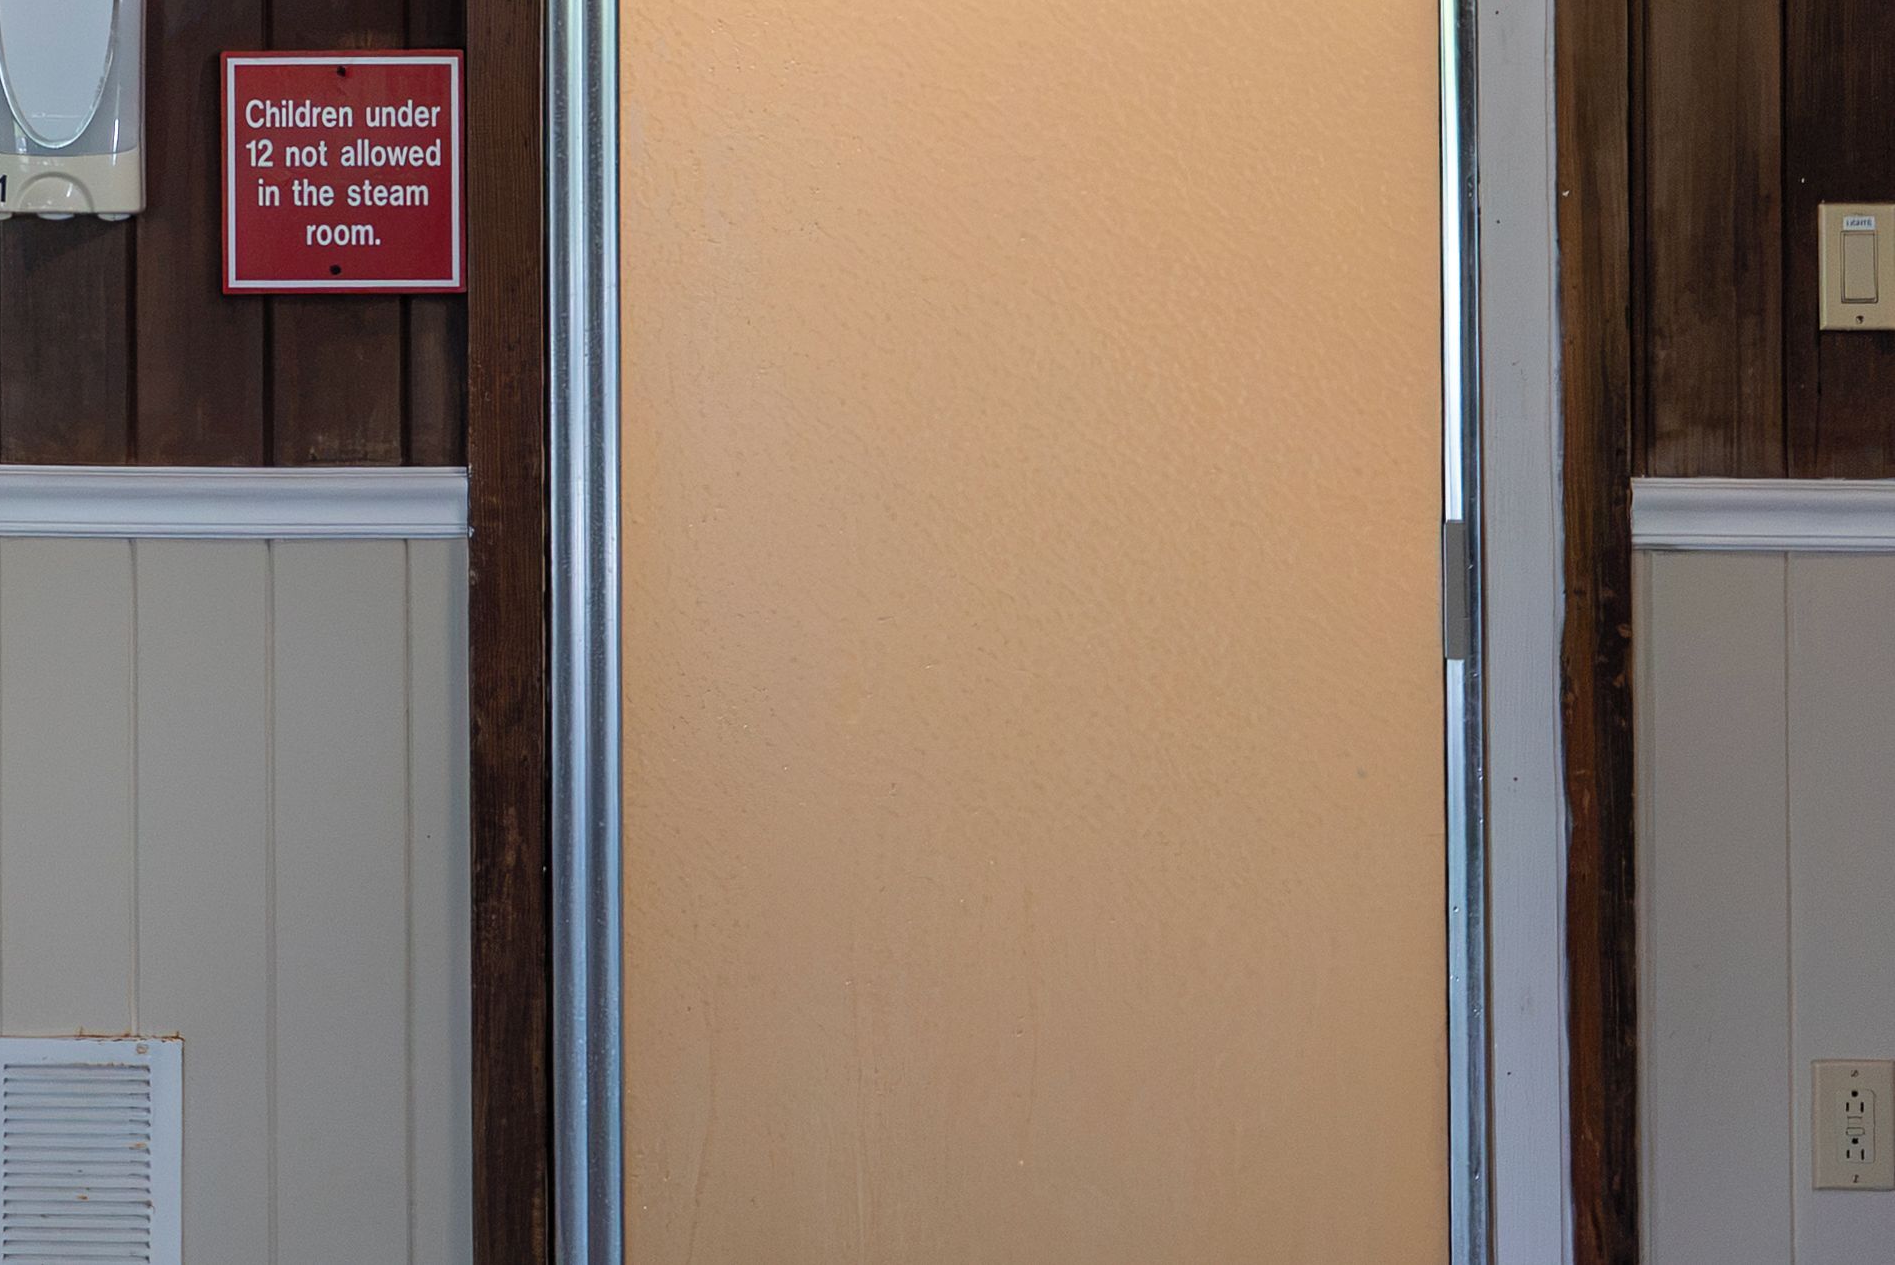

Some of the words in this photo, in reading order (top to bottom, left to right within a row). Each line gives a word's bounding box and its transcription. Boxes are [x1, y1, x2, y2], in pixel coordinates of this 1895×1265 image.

[245, 99, 353, 128] Children
[365, 99, 441, 128] under
[246, 138, 274, 167] 12
[285, 140, 328, 167] not
[340, 138, 441, 167] allowed
[258, 179, 280, 207] in
[292, 179, 335, 207] the
[346, 179, 429, 207] steam
[306, 224, 382, 246] room.
